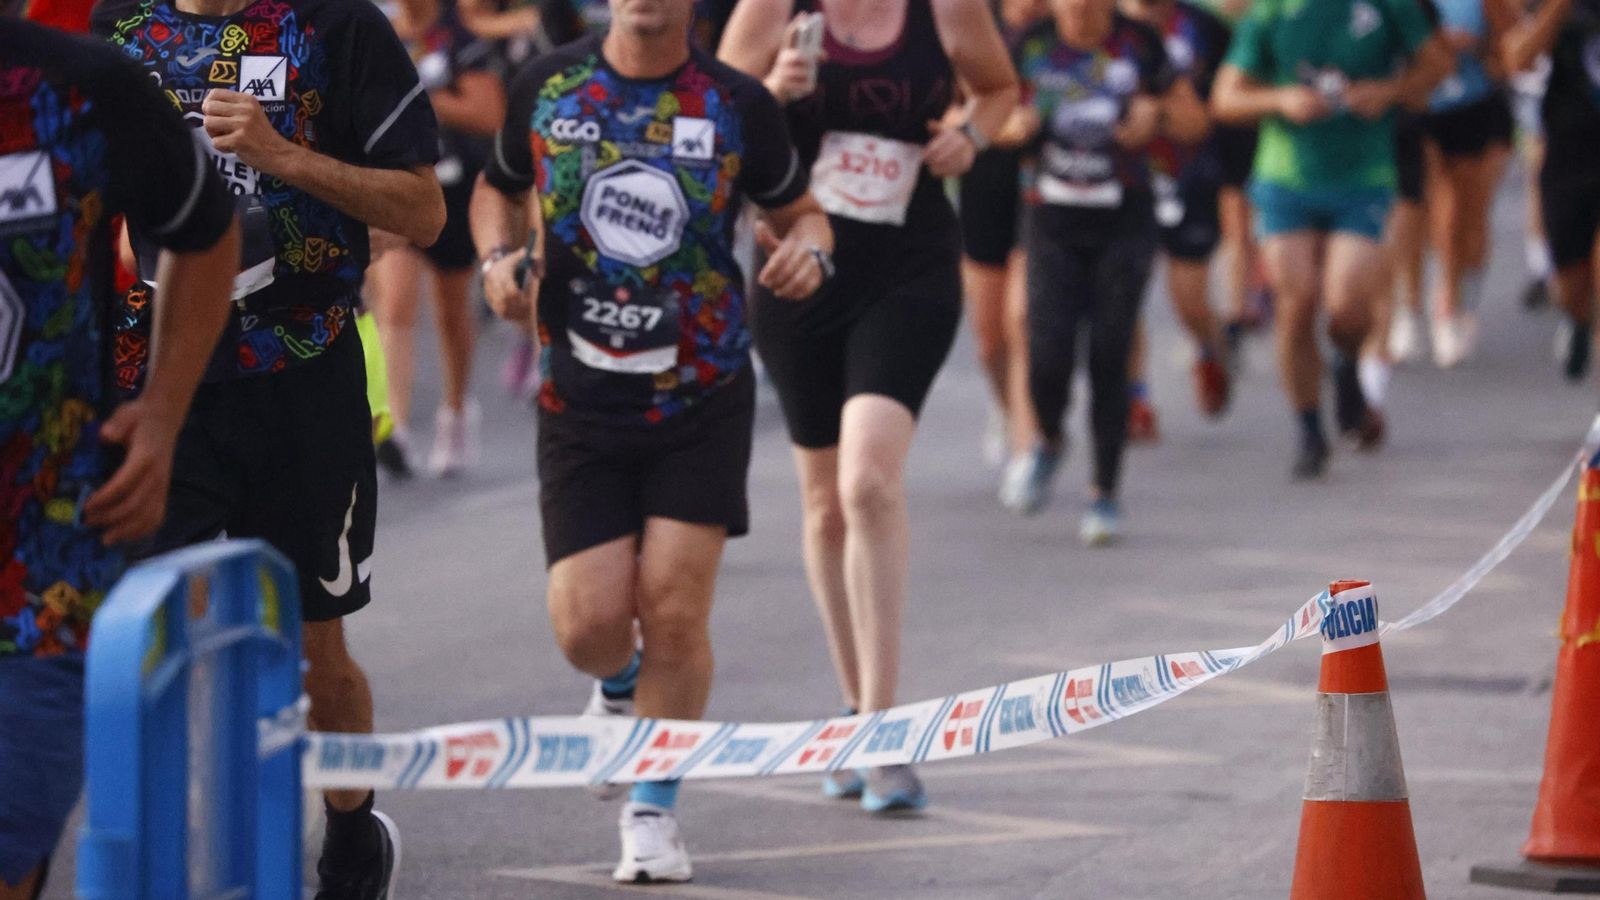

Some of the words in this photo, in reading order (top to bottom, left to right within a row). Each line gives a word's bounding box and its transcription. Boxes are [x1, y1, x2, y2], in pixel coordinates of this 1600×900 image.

[241, 79, 277, 97] AXA
[601, 185, 674, 221] PONLE
[595, 204, 668, 240] FRENO
[582, 297, 664, 332] 2267
[1321, 597, 1377, 640] OLICIA
